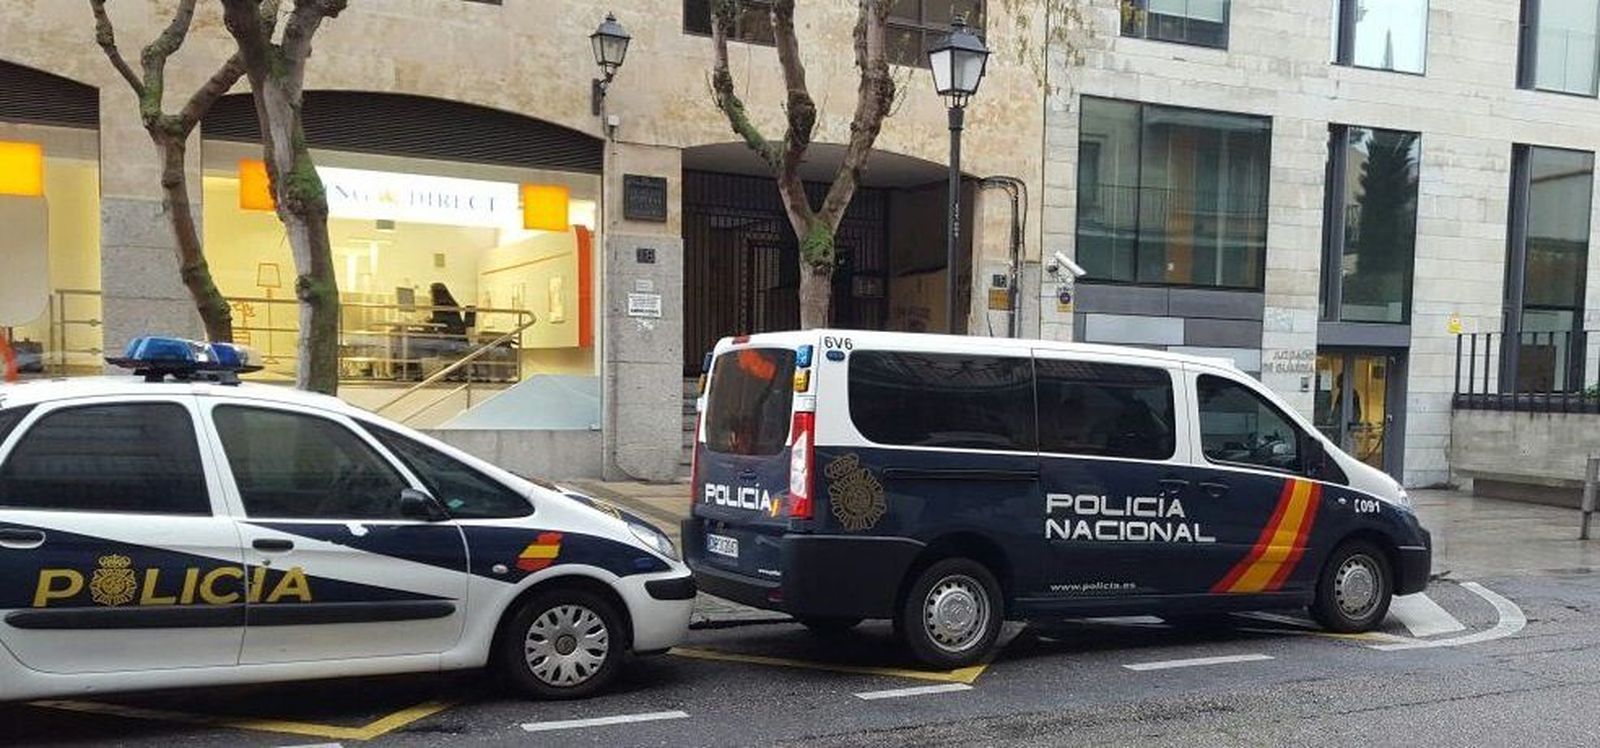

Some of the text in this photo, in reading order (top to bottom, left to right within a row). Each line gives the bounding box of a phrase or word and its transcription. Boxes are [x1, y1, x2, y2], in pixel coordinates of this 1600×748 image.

[824, 336, 853, 350] 6V6
[705, 482, 772, 512] POLICÍA
[1046, 492, 1186, 518] POLICÍA
[1045, 518, 1216, 542] NACIONAL
[1050, 581, 1136, 592] www.policia.es
